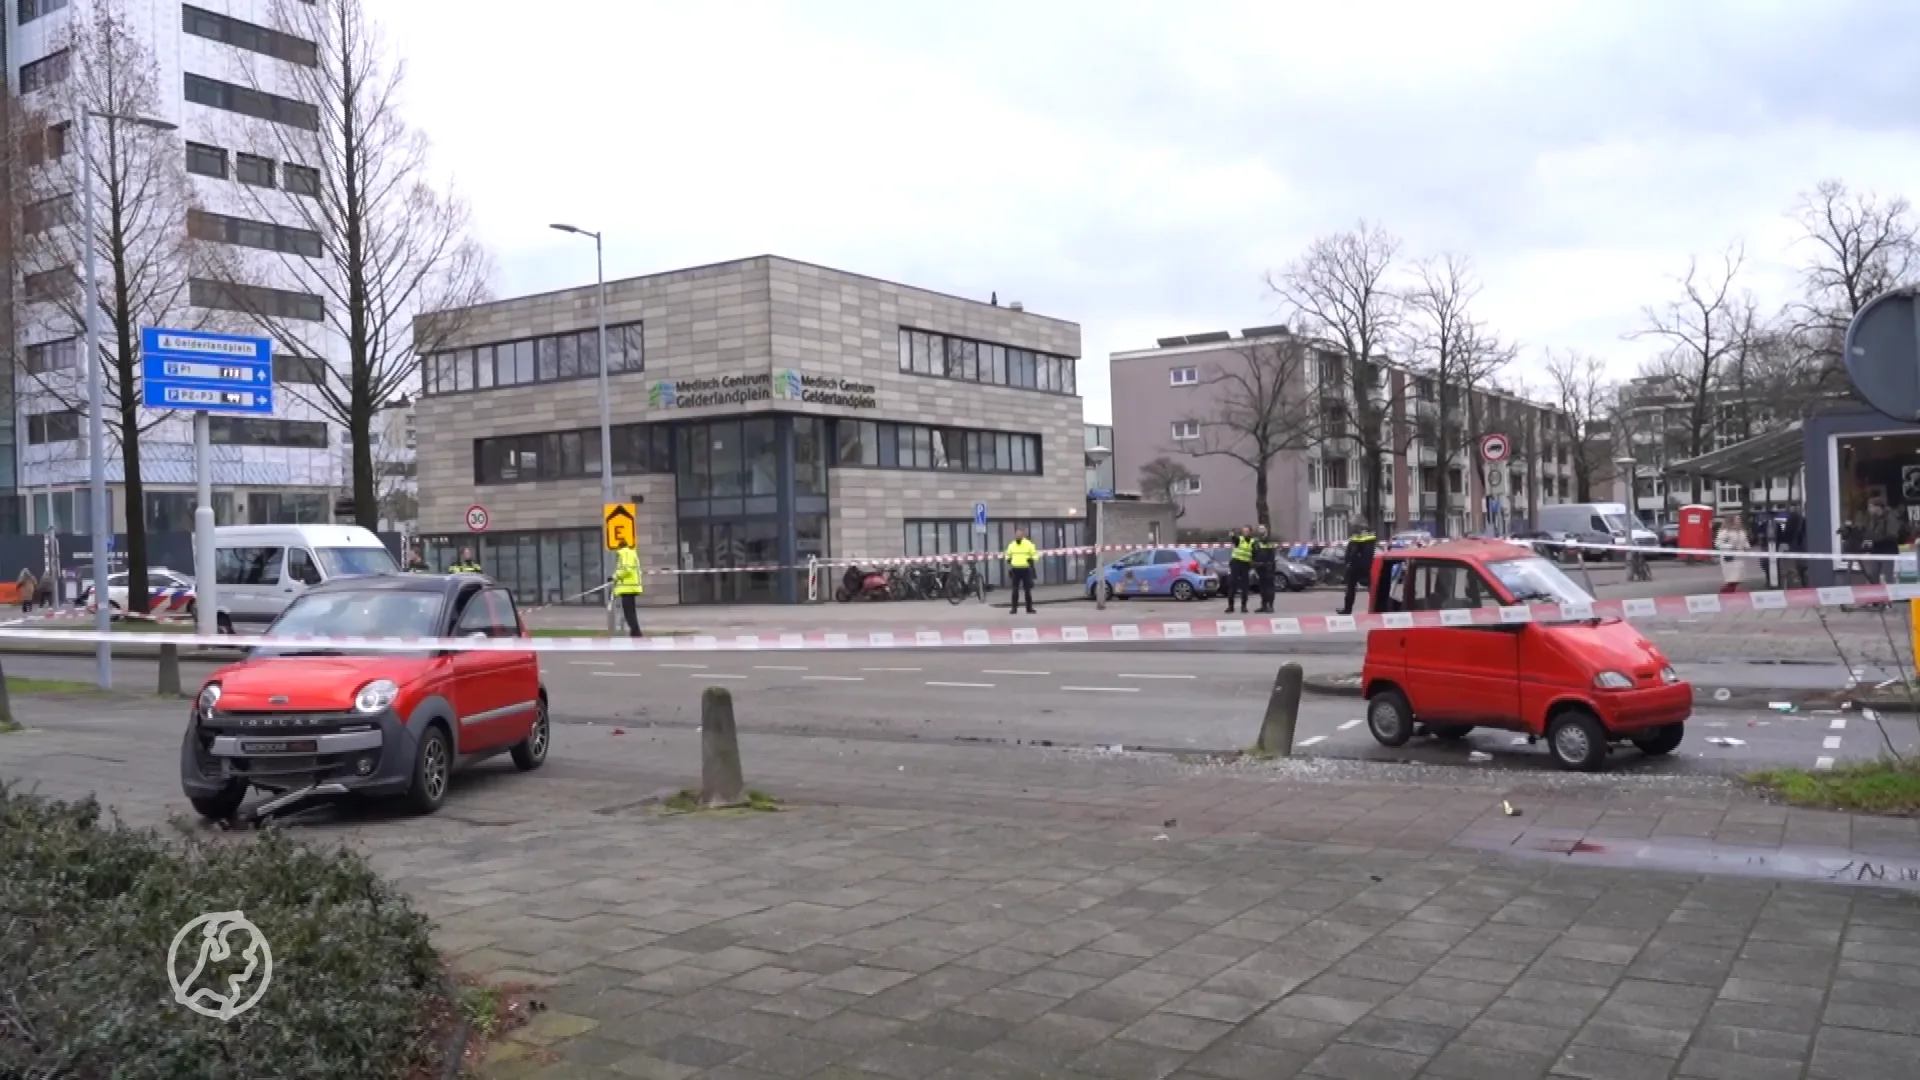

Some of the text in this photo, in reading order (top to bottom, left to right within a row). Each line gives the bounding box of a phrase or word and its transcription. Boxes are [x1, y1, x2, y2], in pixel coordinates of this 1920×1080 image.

[174, 338, 252, 353] Gelderlandplein
[676, 373, 769, 392] Medisch Centrum
[801, 375, 875, 394] Medisch Centrum
[676, 388, 770, 409] Gelderlandplein
[801, 389, 876, 409] Gelderlandplein
[471, 513, 485, 525] 30
[614, 525, 625, 541] E
